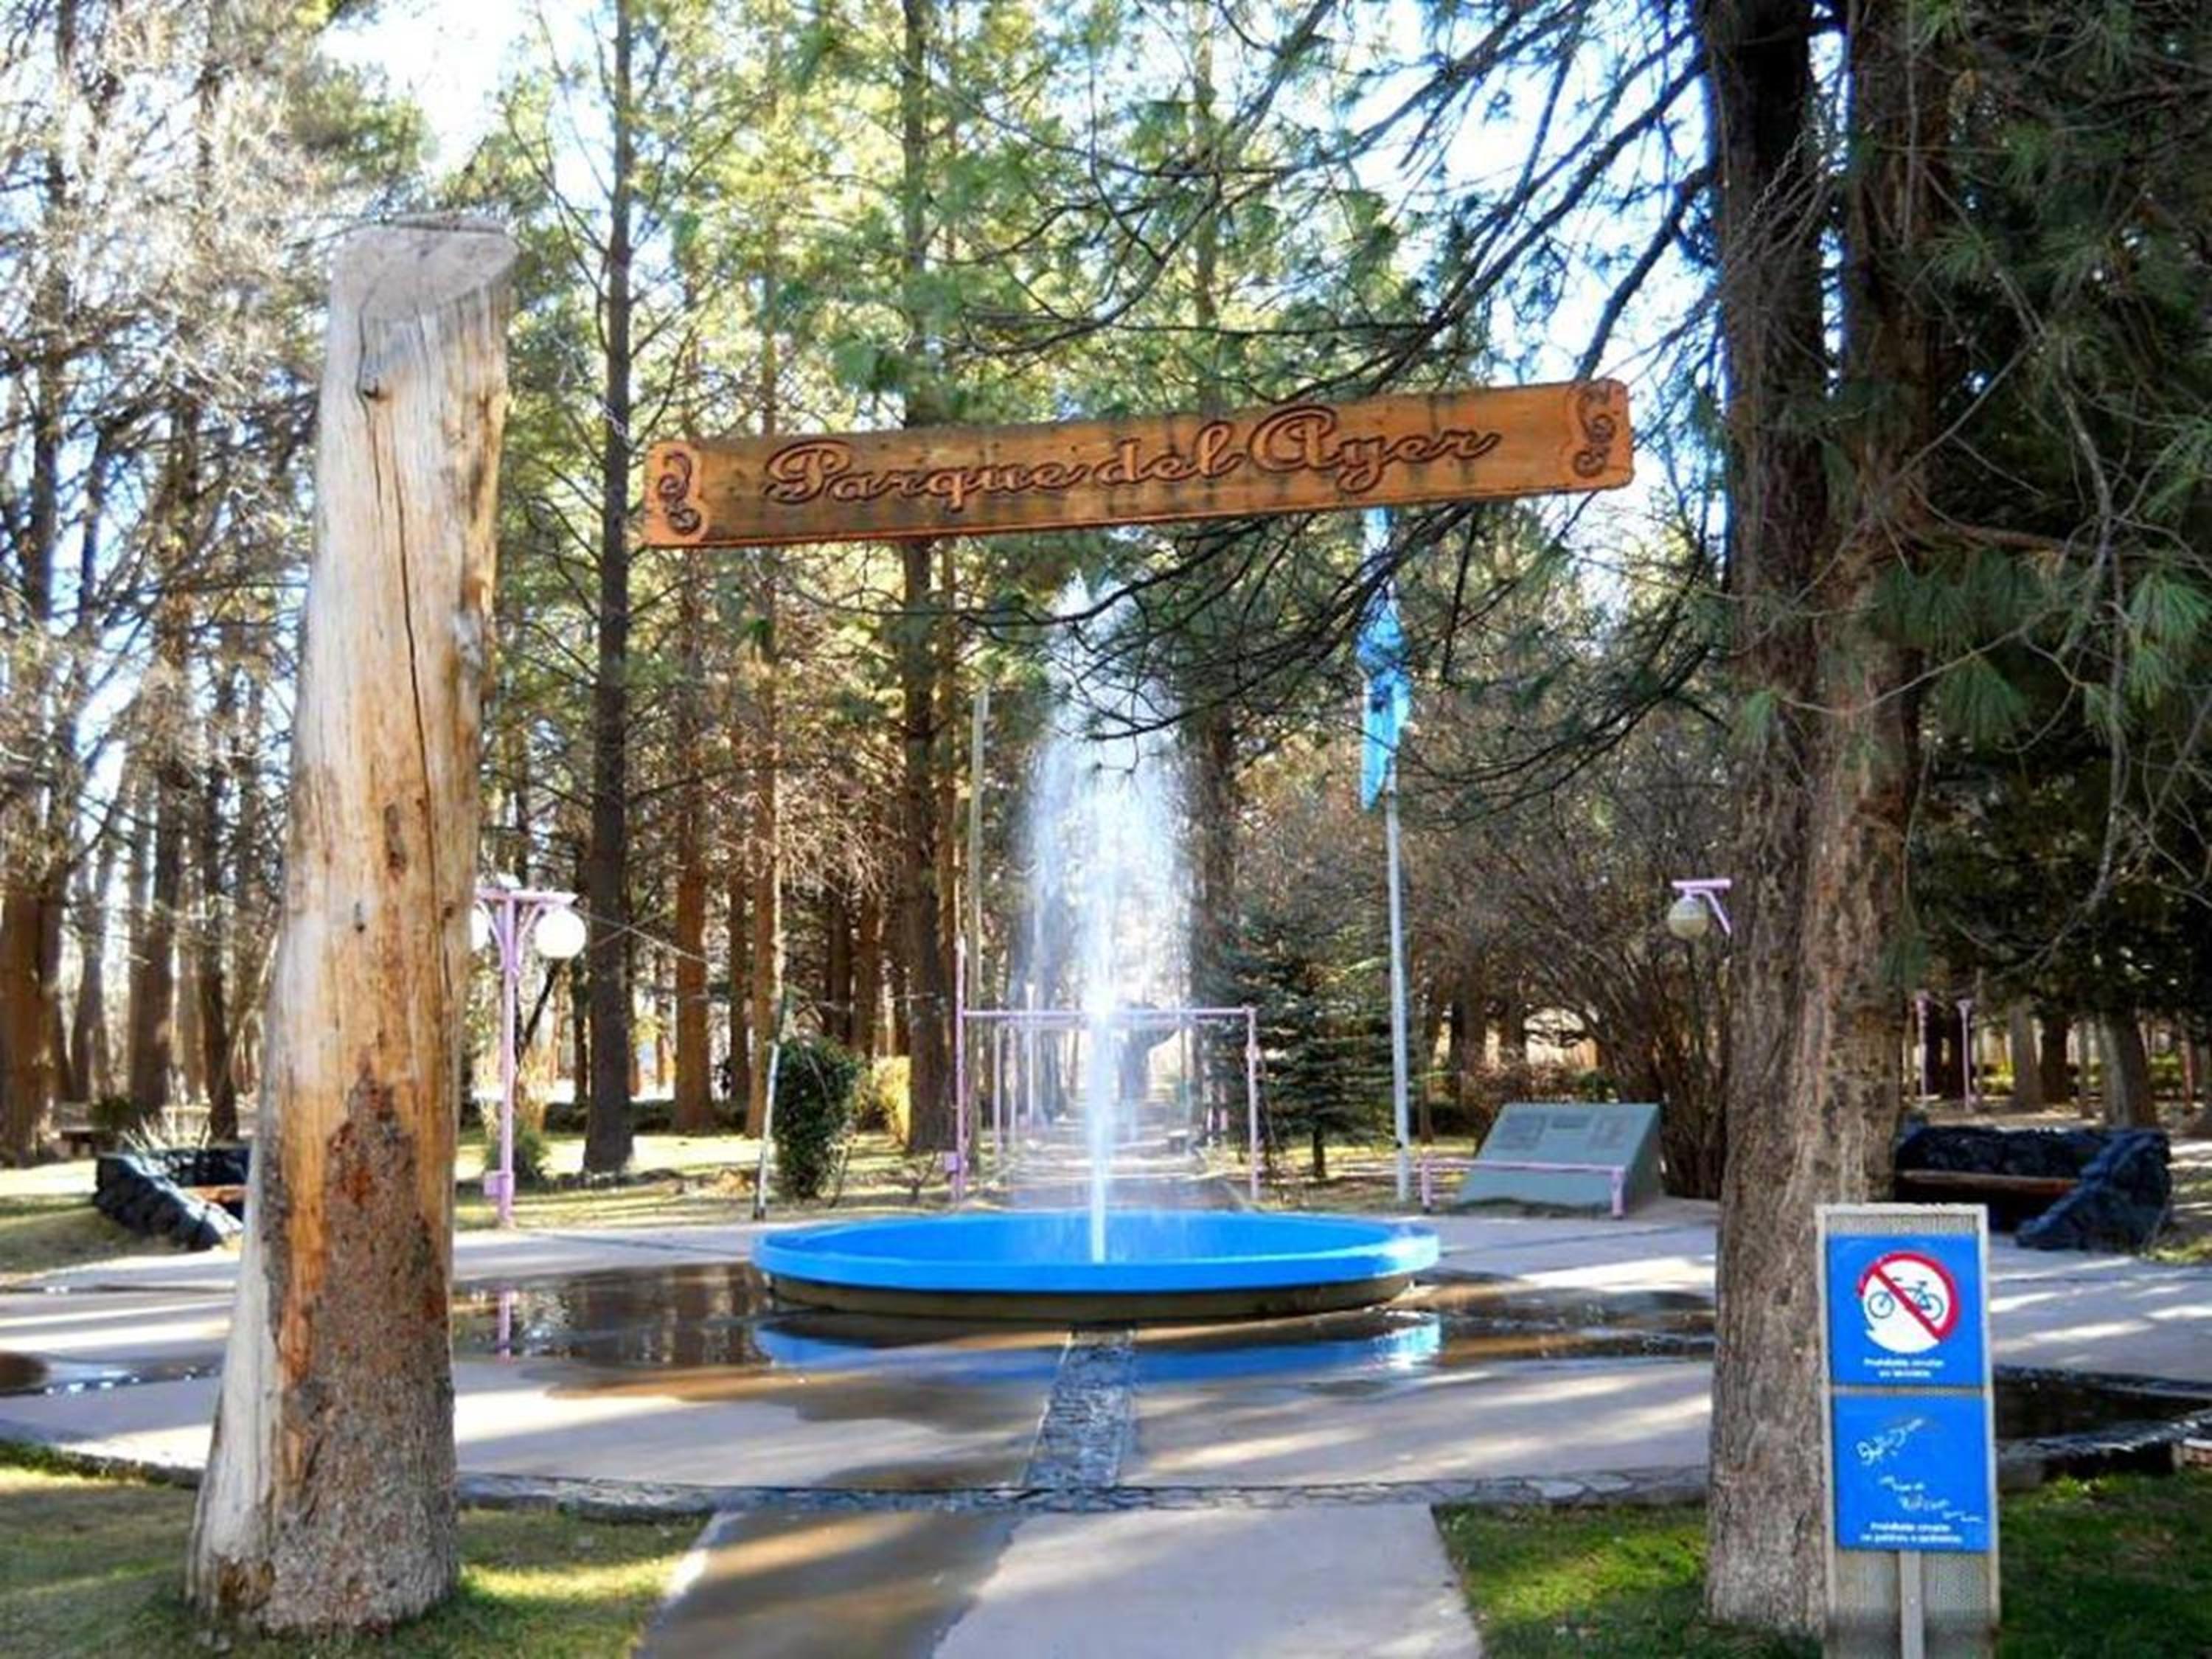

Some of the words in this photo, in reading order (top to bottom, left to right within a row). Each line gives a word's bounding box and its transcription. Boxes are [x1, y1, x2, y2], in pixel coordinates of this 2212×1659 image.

[763, 439, 1091, 513] Parque
[1093, 420, 1248, 487] del
[1248, 404, 1503, 494] Ayer
